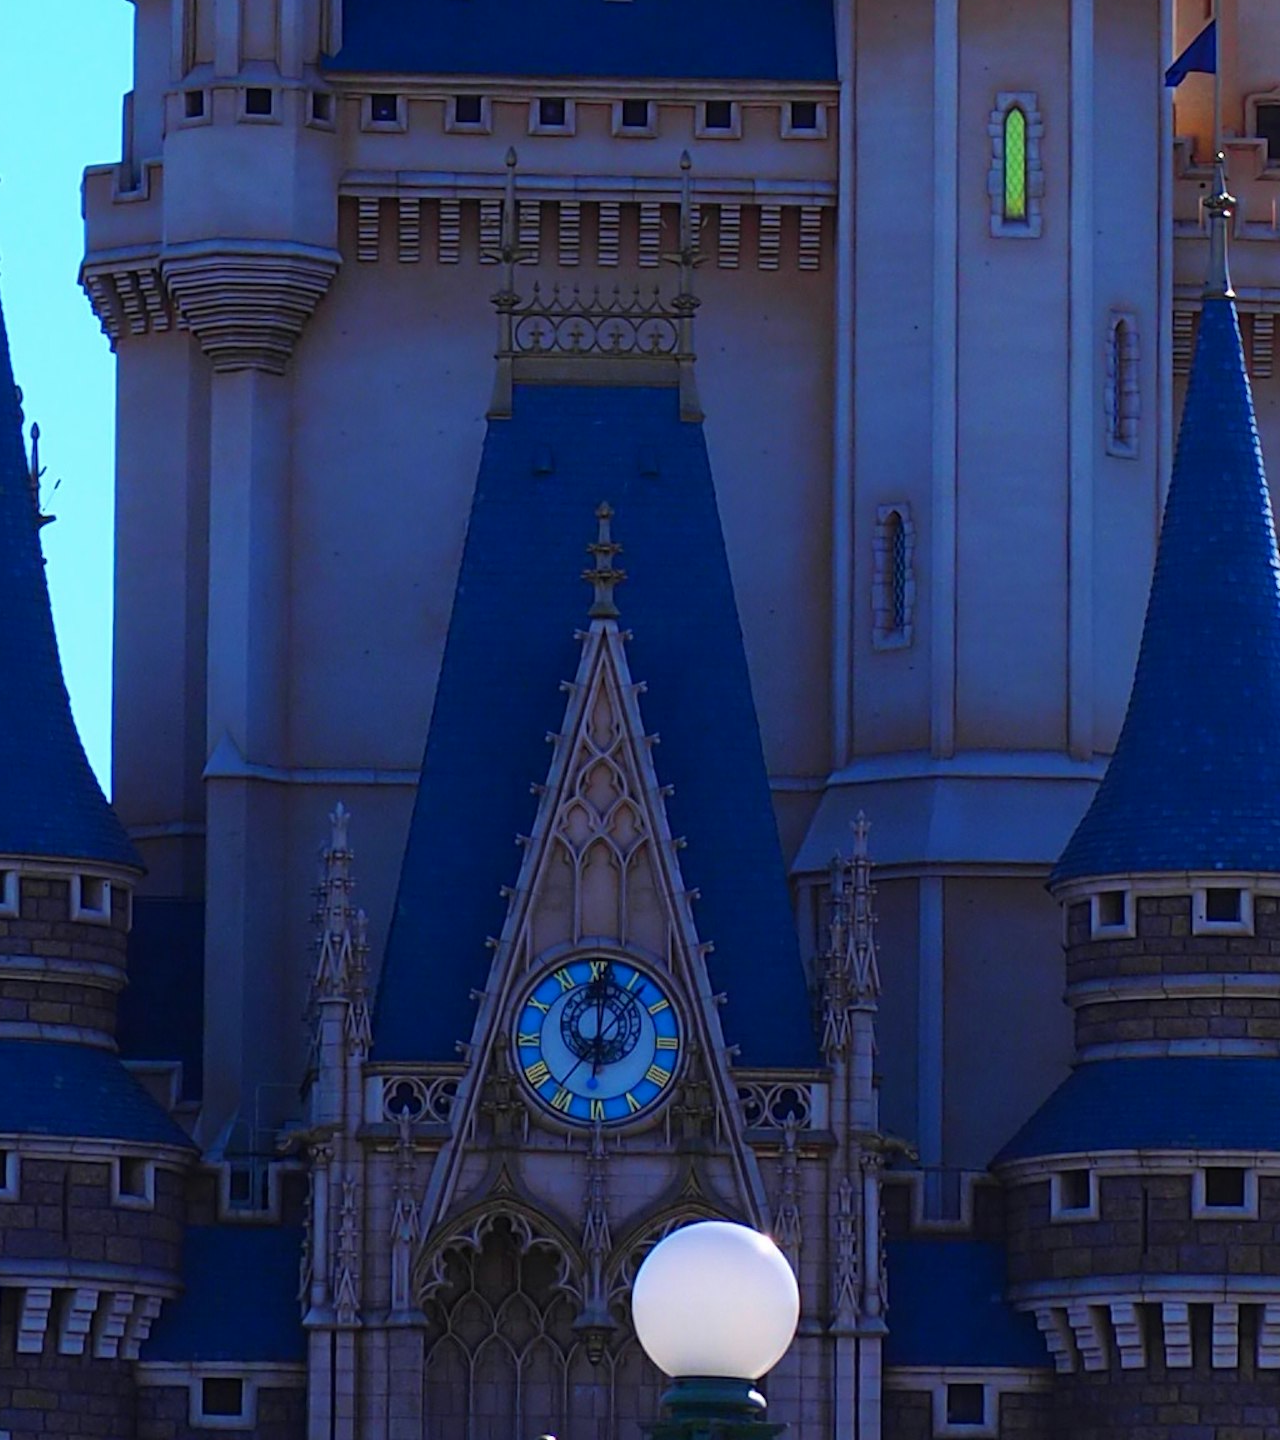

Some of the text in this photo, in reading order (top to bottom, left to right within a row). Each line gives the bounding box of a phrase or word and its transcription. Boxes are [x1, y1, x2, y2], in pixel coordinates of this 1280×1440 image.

[553, 968, 575, 992] XI
[527, 995, 550, 1014] X
[648, 999, 670, 1015] II
[518, 1032, 540, 1047] IX
[656, 1037, 678, 1050] III
[524, 1060, 551, 1089] VIII
[645, 1064, 671, 1088] IIII
[551, 1085, 573, 1112] VII
[625, 1092, 641, 1113] V
[590, 1099, 606, 1121] VI
